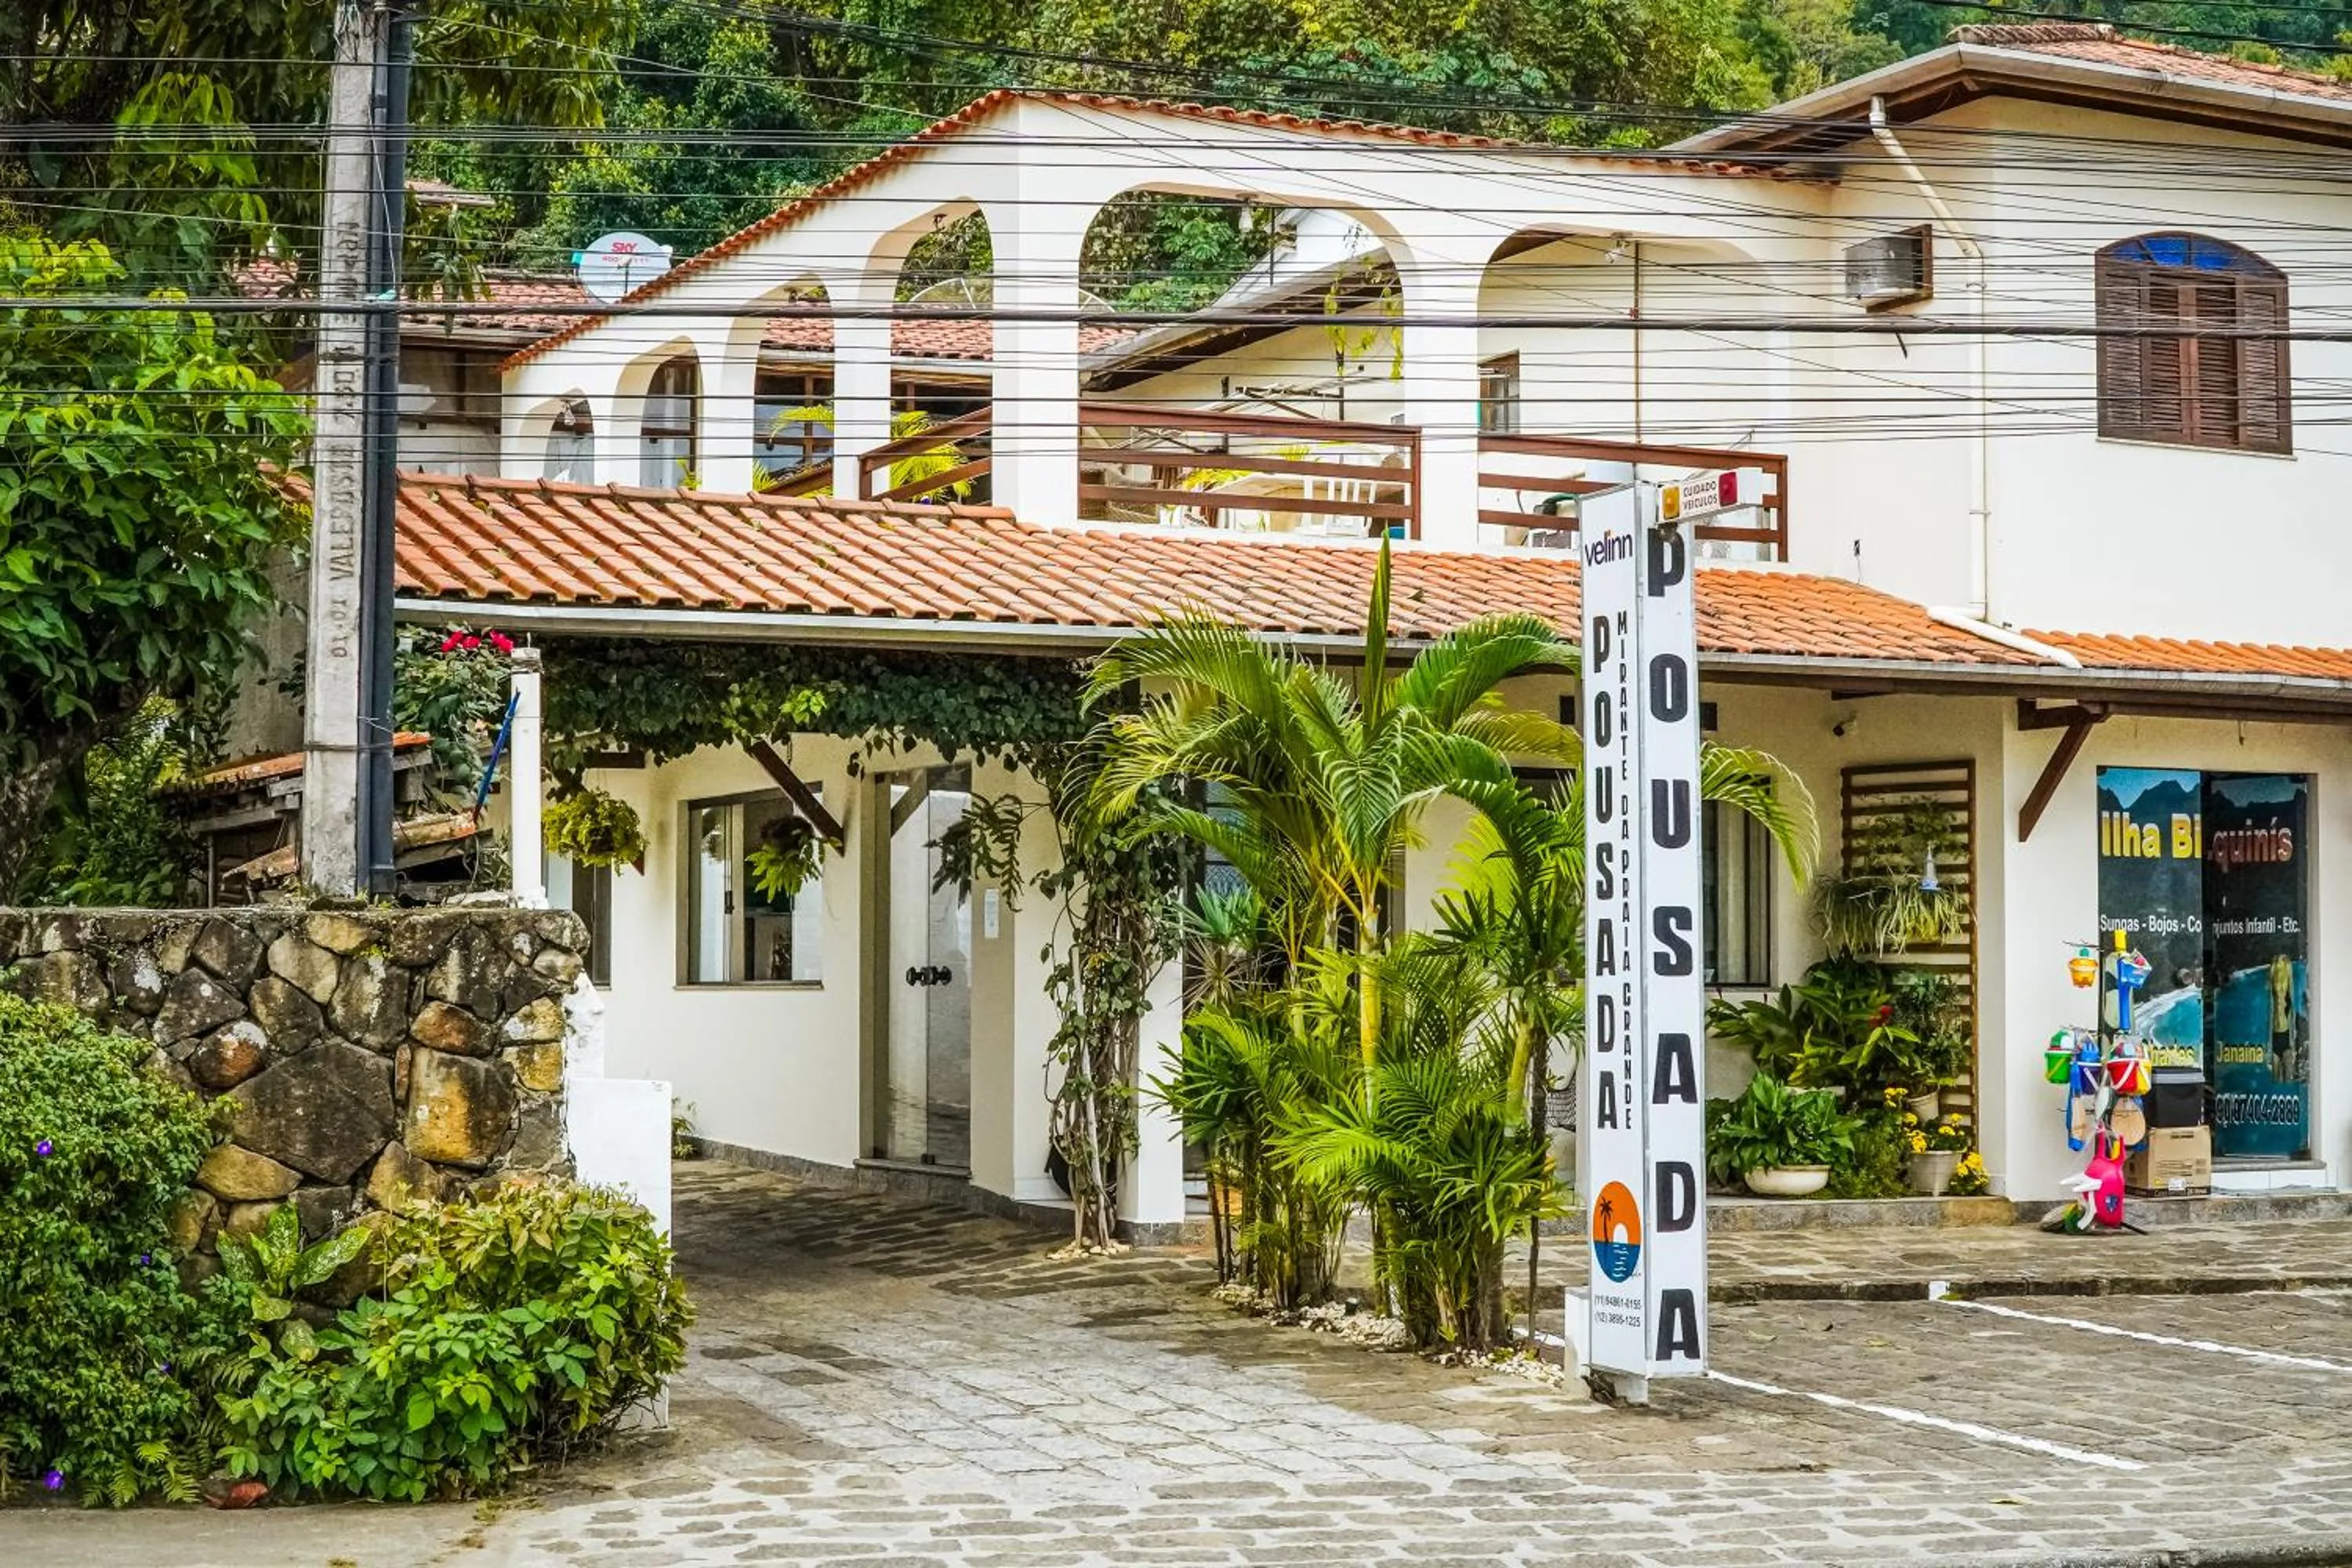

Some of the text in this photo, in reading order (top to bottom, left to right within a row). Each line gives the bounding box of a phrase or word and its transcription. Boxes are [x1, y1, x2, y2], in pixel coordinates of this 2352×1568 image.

[1683, 481, 1716, 497] CUIDADO
[1584, 530, 1633, 568] velinn
[2101, 811, 2161, 858] Ilha
[1592, 615, 1617, 1130] POUSADA
[1617, 609, 1632, 1130] MIRANTE DA PRAIA GRANDE
[1647, 528, 1700, 1361] POUSADA
[2148, 915, 2179, 936] Bojos
[2245, 916, 2275, 933] Infantil
[2283, 916, 2301, 933] Etc.
